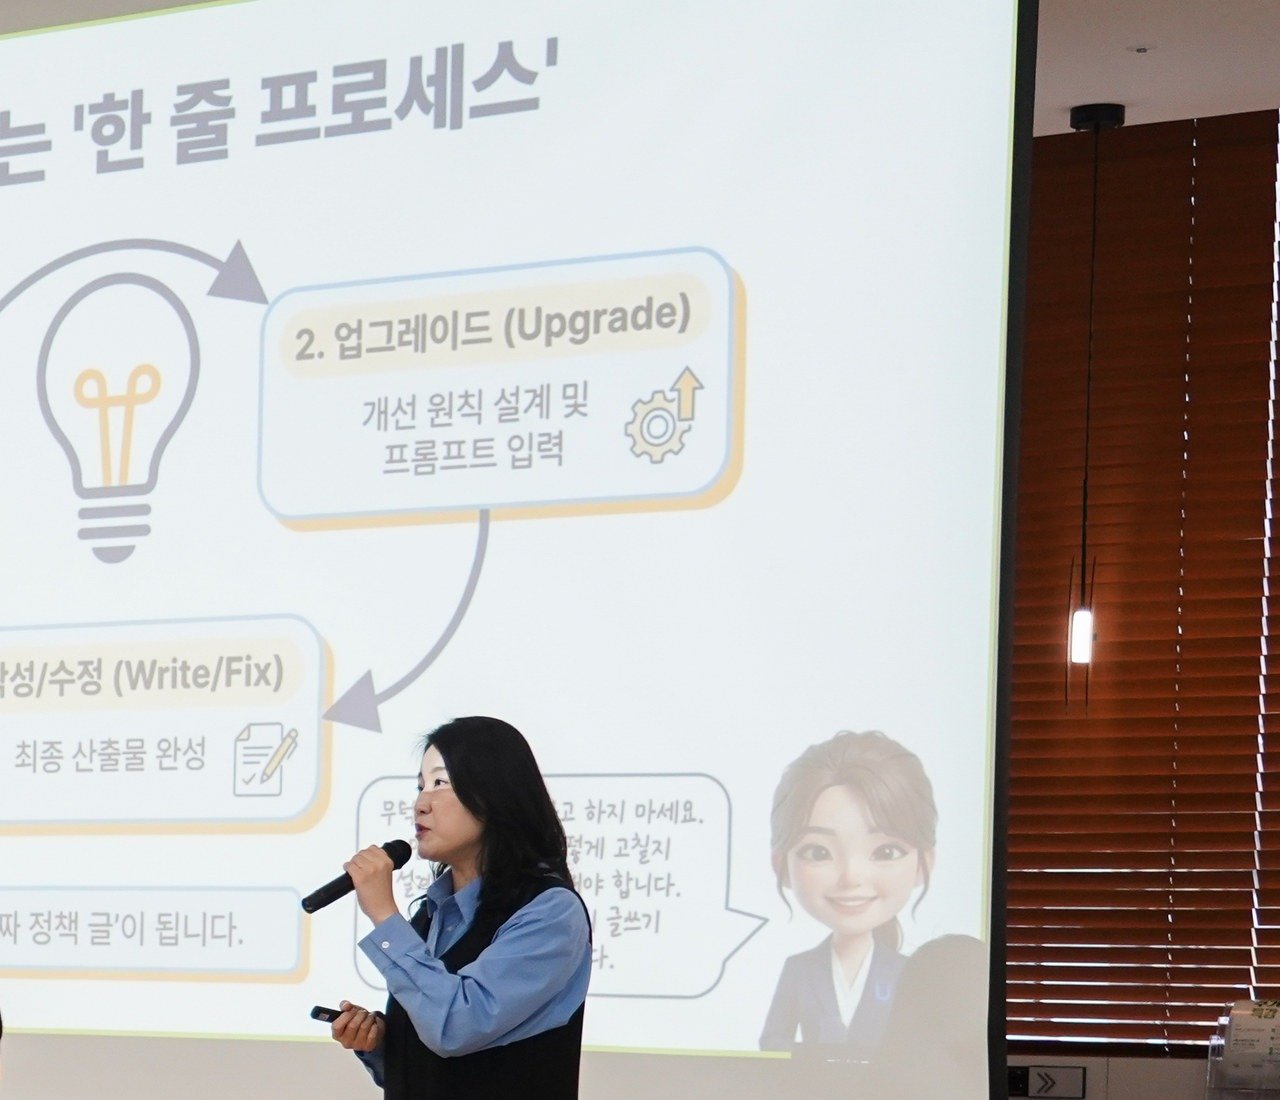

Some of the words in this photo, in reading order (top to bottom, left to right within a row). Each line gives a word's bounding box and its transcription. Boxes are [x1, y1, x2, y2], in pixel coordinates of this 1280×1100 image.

[73, 91, 151, 175] '한
[170, 80, 237, 162] 줄
[255, 37, 560, 148] 프로세스'
[295, 328, 325, 360] 2.
[335, 309, 493, 360] 업그레이드
[504, 292, 692, 349] (Upgrade)
[362, 393, 417, 432] 개선
[427, 387, 484, 428] 원칙
[493, 382, 552, 423] 설계
[561, 379, 589, 419] 및
[382, 435, 498, 476] 프롬프트
[507, 430, 565, 469] 입력
[113, 653, 284, 698] (Write/Fix)
[14, 739, 64, 774] 최종
[71, 737, 148, 773] 산출물
[155, 736, 207, 771] 완성
[584, 799, 626, 825] 하지
[634, 799, 704, 825] 마세요.
[567, 835, 605, 864] 떻게
[613, 833, 671, 865] 고칠지
[611, 869, 681, 900] 합니다.
[28, 910, 79, 945] 정책
[155, 912, 245, 948] 됩니다.
[606, 905, 661, 938] 글쓰기
